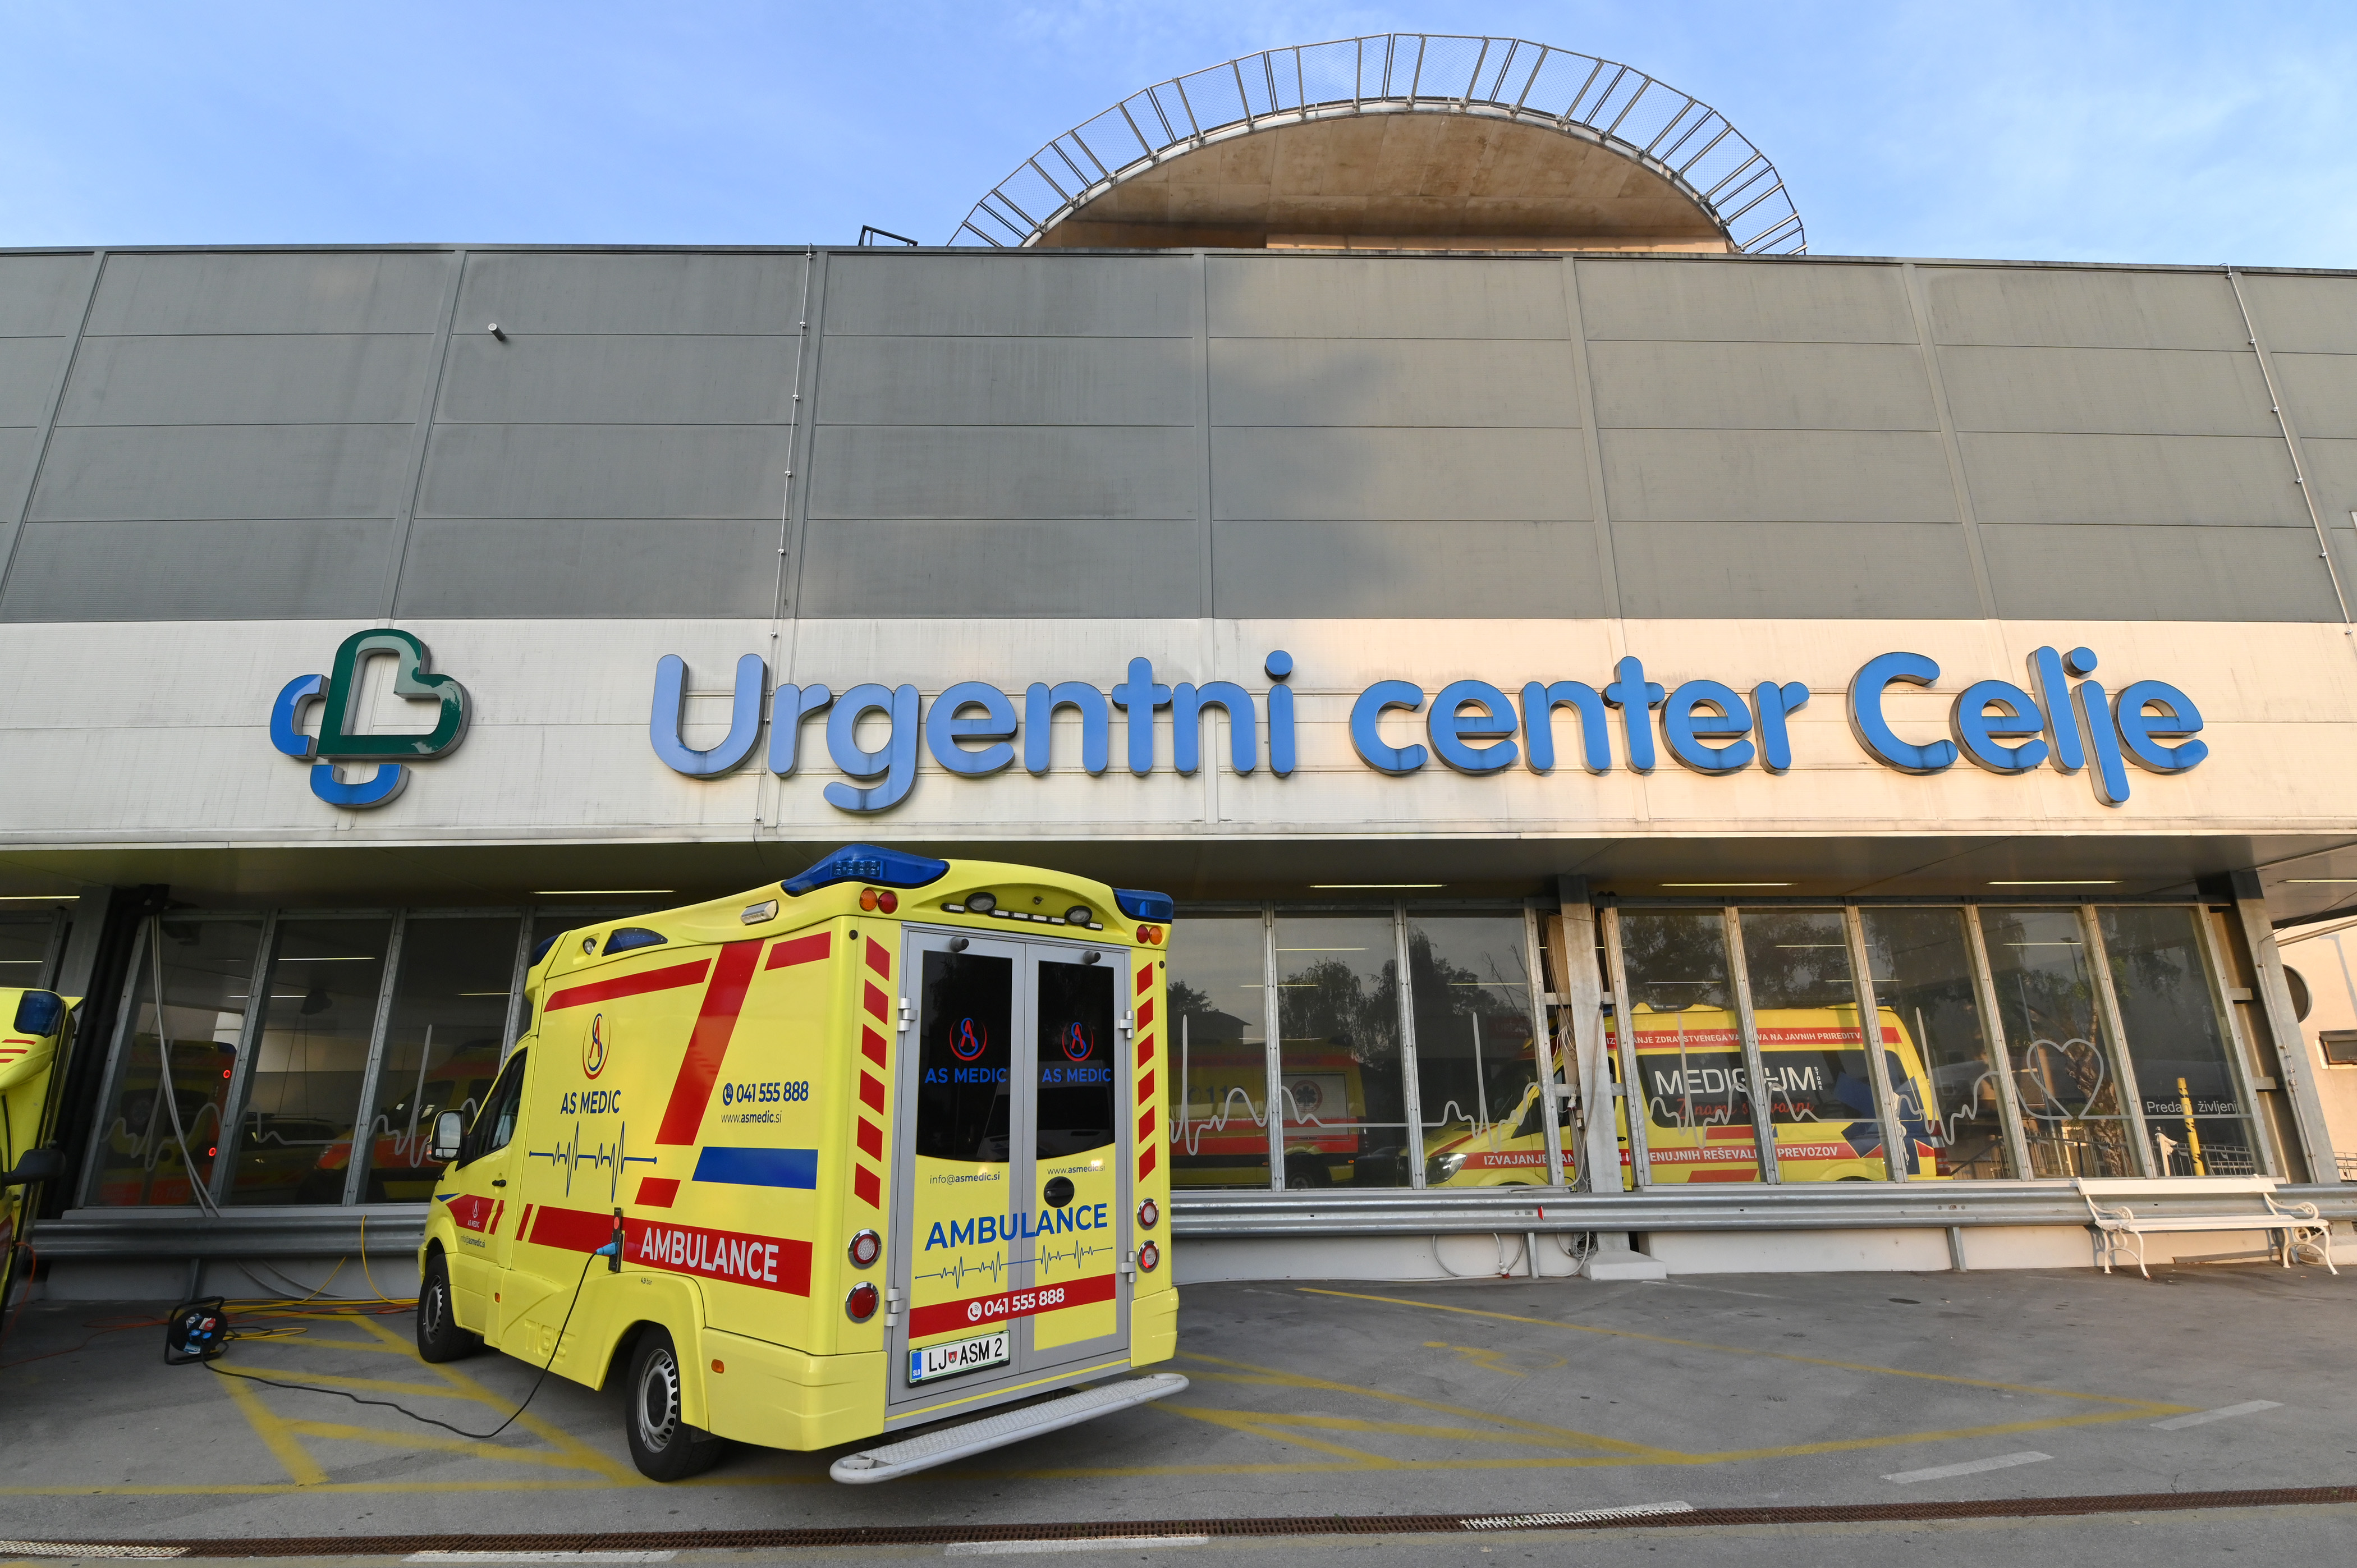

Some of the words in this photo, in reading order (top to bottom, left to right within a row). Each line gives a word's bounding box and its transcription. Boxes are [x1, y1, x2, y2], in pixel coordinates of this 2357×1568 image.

[649, 649, 1295, 814] Urgentni
[1348, 655, 1810, 776] center
[1846, 645, 2209, 808] Celje
[925, 1068, 948, 1083] AS
[954, 1068, 1006, 1083] MEDIC
[1042, 1069, 1062, 1083] AS
[1067, 1068, 1111, 1082] MEDIC
[1814, 1067, 1823, 1090] STORE
[560, 1092, 577, 1114] AS
[580, 1089, 621, 1113] MEDIC
[736, 1083, 756, 1103] 041
[758, 1082, 781, 1102] 555
[783, 1080, 809, 1102] 888
[721, 1110, 782, 1123] www.asmedic.si
[1777, 1147, 1838, 1158] PREVOZOV
[930, 1171, 1000, 1185] info@asmedic.si
[1047, 1163, 1105, 1175] www.asmedic.si
[924, 1203, 1108, 1251] AMBULANCE
[640, 1227, 779, 1282] AMBULANCE
[984, 1298, 1008, 1316] 041
[1012, 1293, 1035, 1311] 555
[1039, 1287, 1065, 1306] 888
[929, 1349, 947, 1372] LJ
[960, 1340, 989, 1365] ASM
[994, 1338, 1002, 1358] 2
